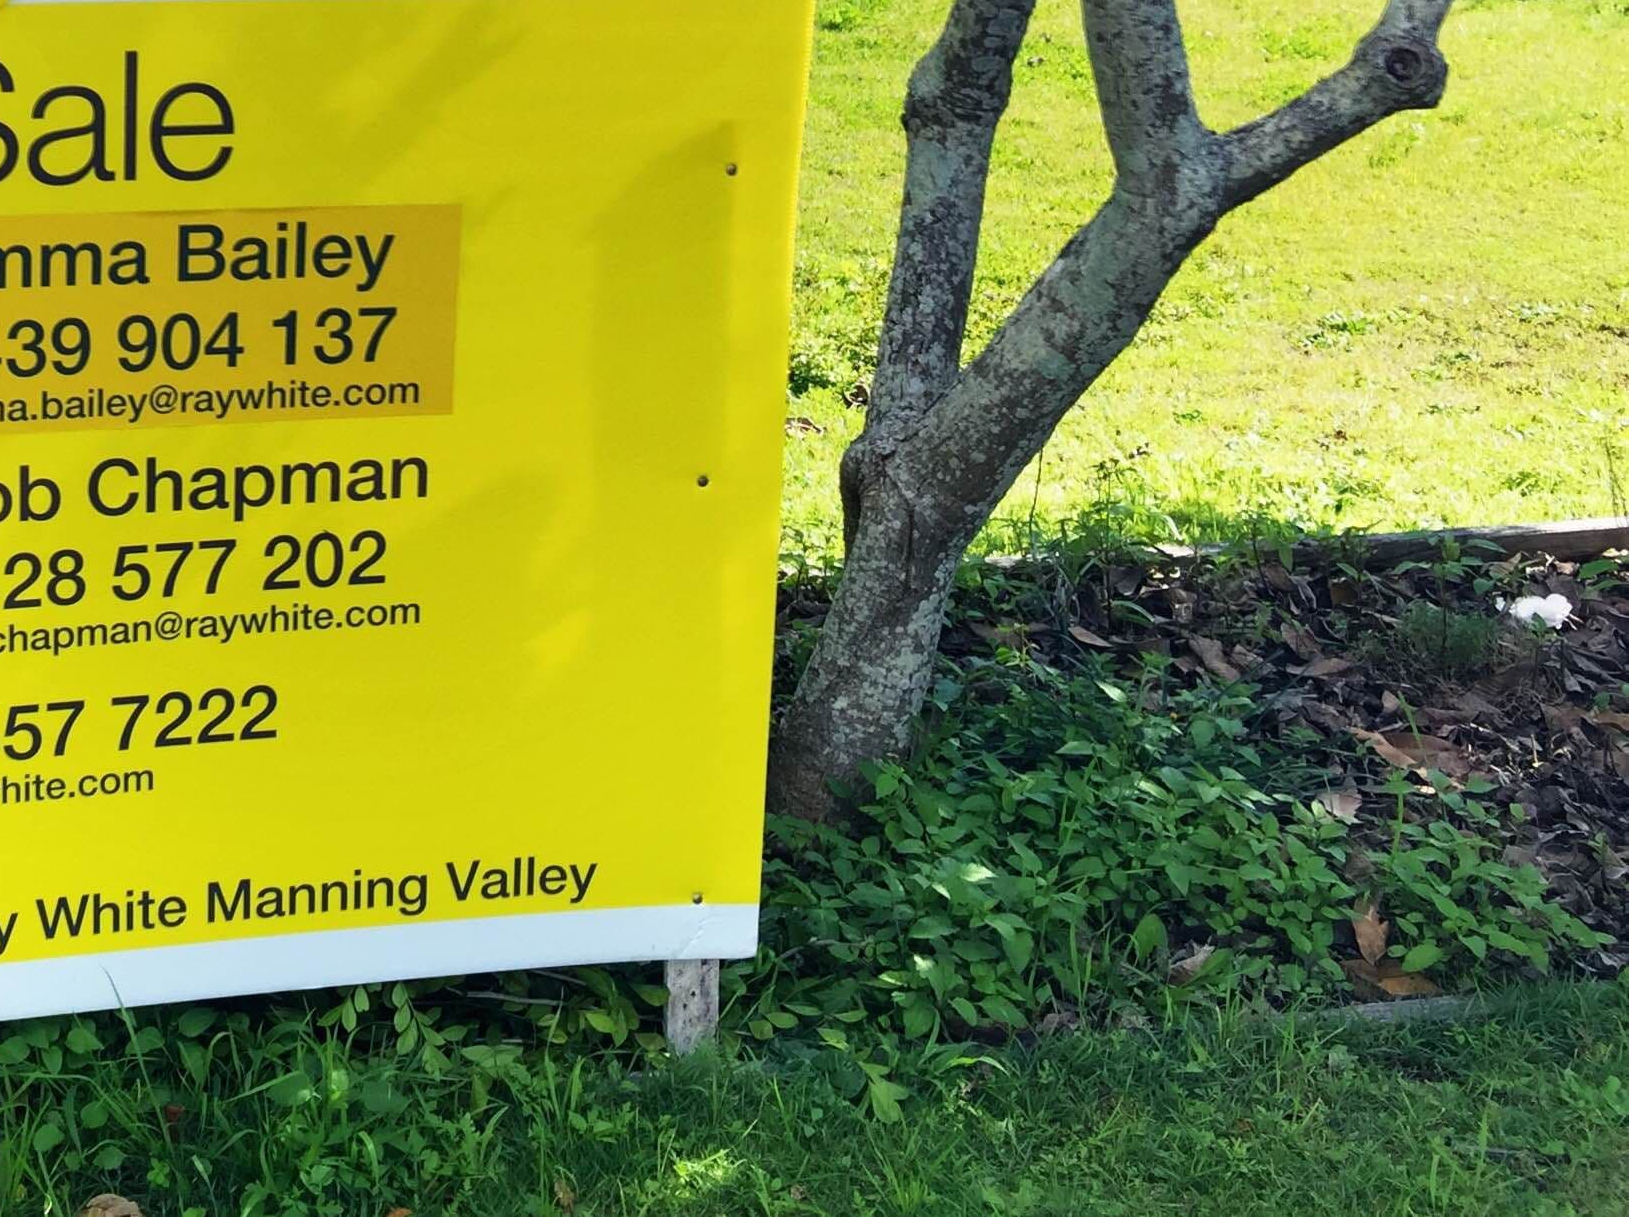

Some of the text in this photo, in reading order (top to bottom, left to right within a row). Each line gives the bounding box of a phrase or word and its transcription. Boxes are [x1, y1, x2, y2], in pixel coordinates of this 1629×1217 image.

[174, 220, 394, 290] Bailey
[115, 312, 245, 375] 904
[271, 305, 398, 368] 137
[86, 452, 431, 524] Chapman
[110, 537, 237, 601] 577
[261, 529, 388, 592] 202
[109, 683, 279, 752] 7222
[35, 888, 188, 942] White
[205, 868, 430, 925] Manning
[445, 854, 598, 906] Valley
